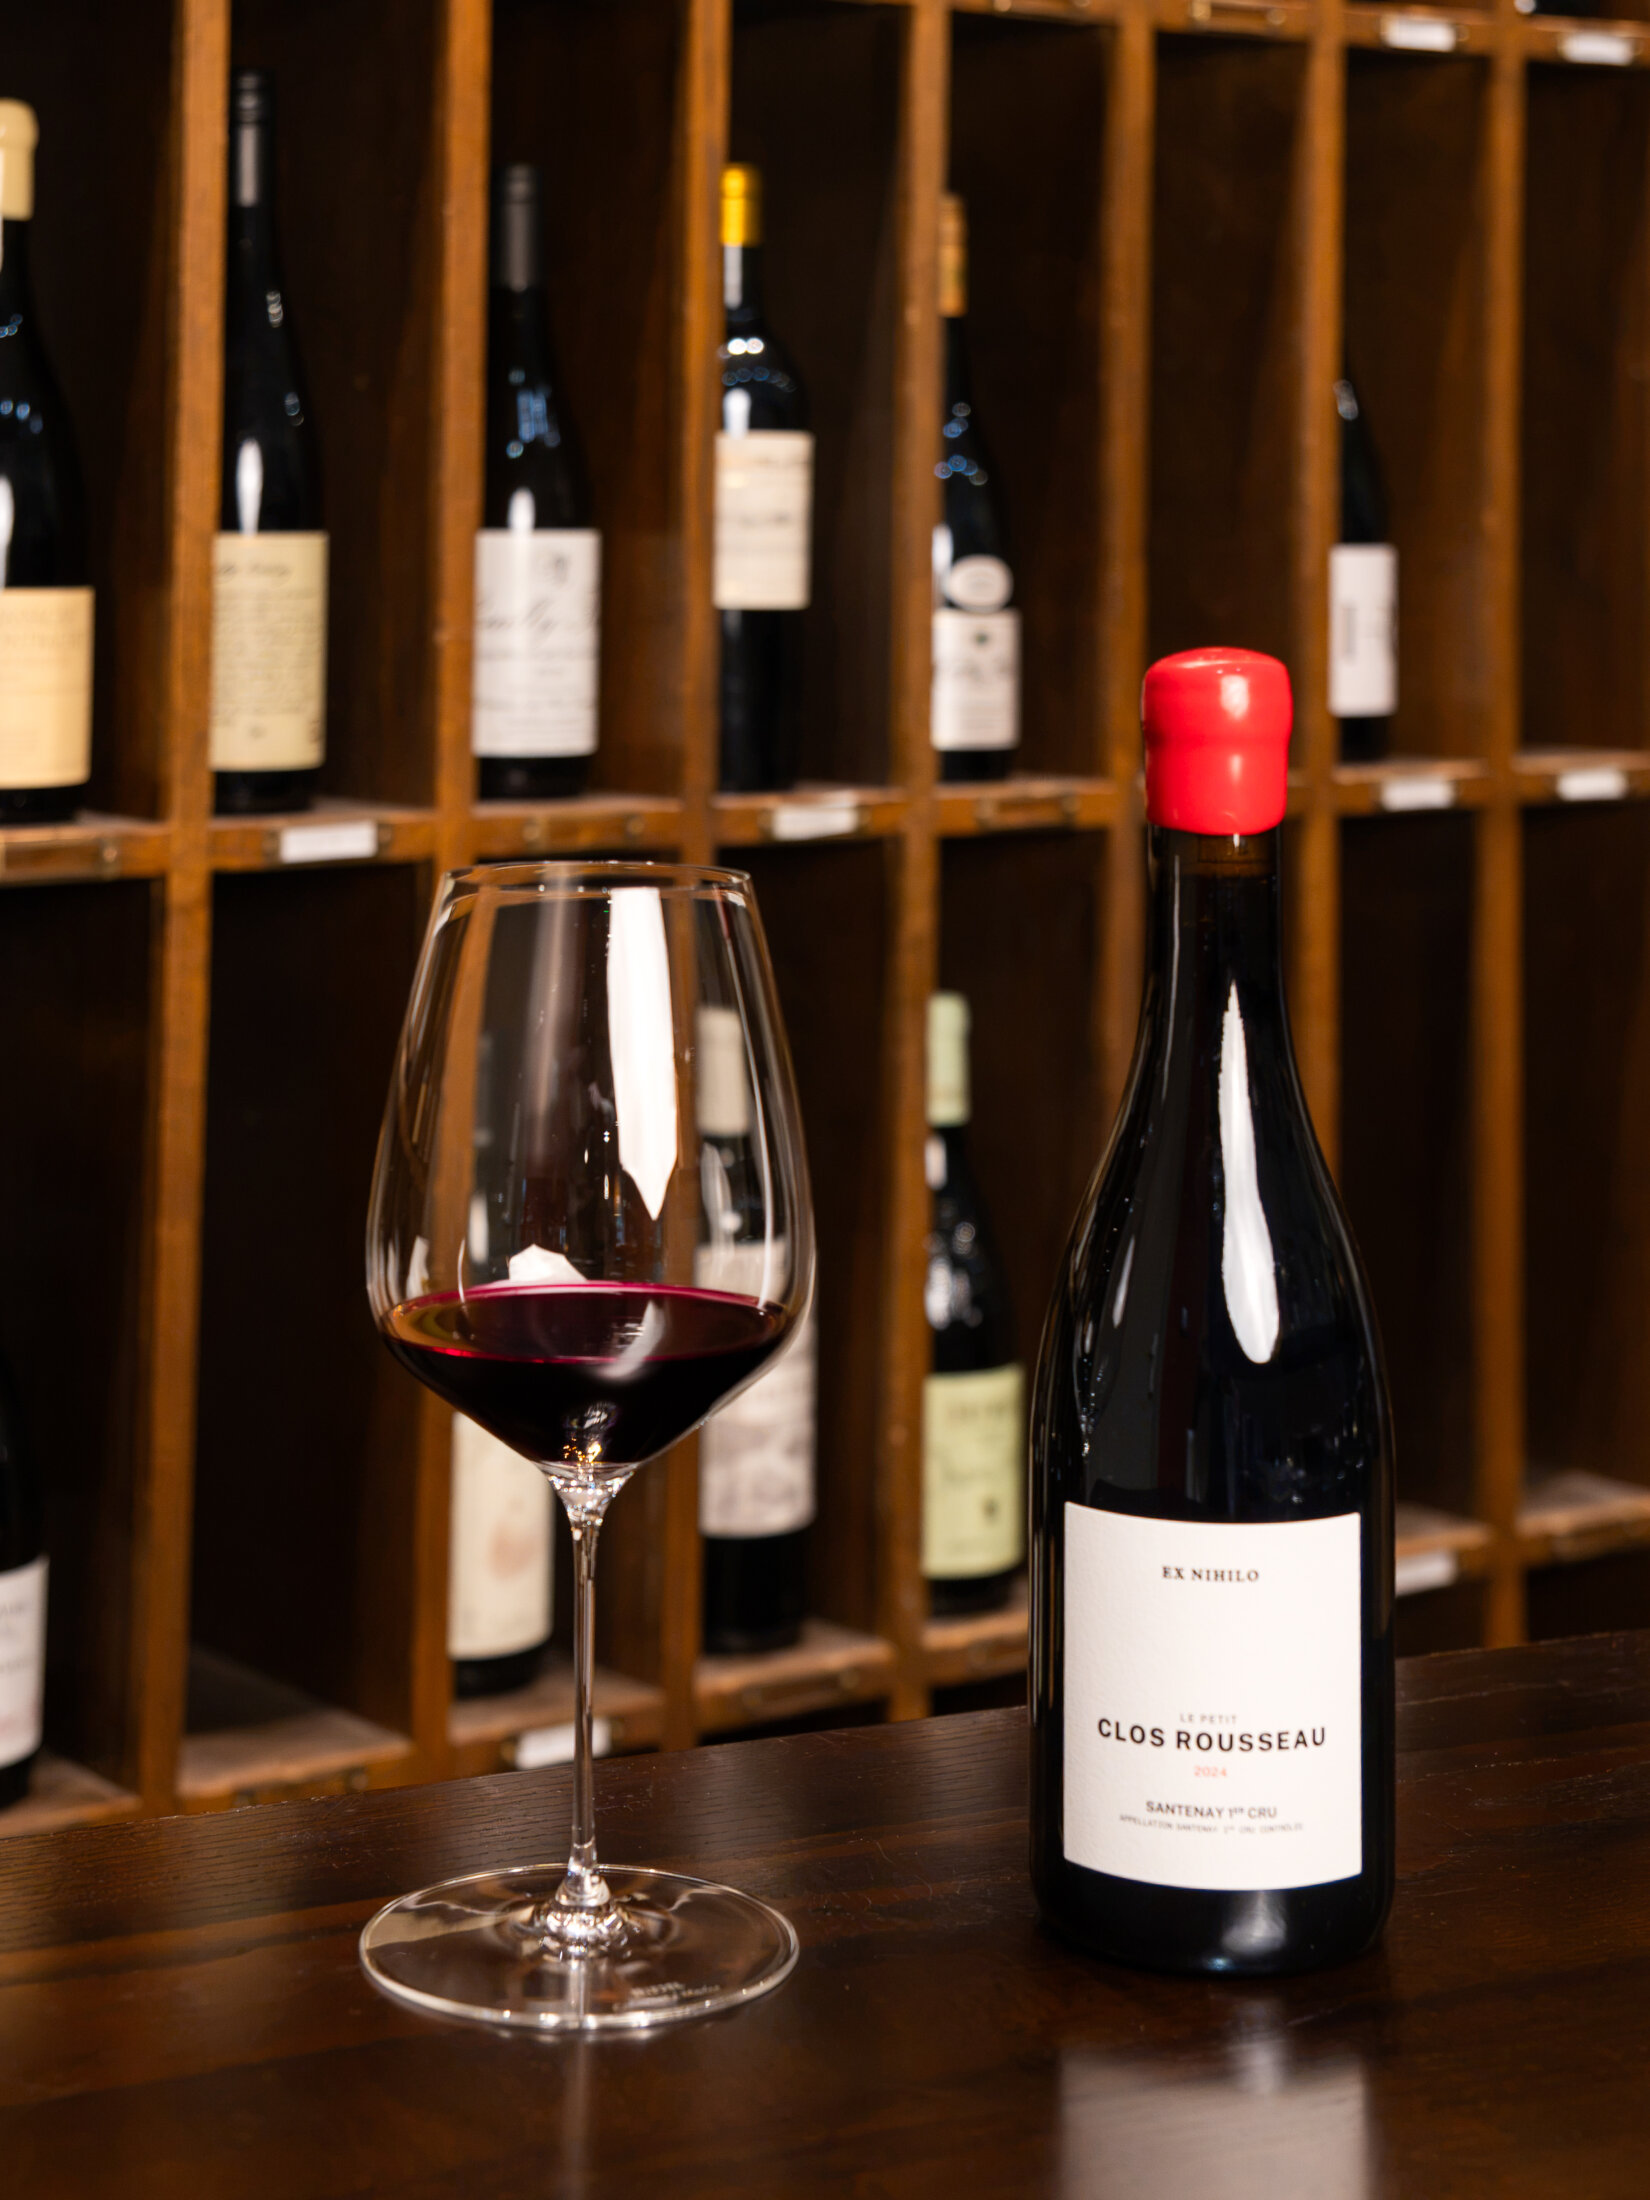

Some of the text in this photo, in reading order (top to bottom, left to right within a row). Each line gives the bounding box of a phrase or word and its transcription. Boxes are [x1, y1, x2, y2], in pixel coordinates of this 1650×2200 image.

[1162, 1566, 1259, 1582] EX NIHILO
[1179, 1713, 1237, 1725] LE PETIT
[1097, 1717, 1326, 1752] CLOS ROUSSEAU
[1193, 1765, 1228, 1779] 2024
[1145, 1800, 1224, 1820] SANTENAY
[1247, 1806, 1278, 1820] CRU
